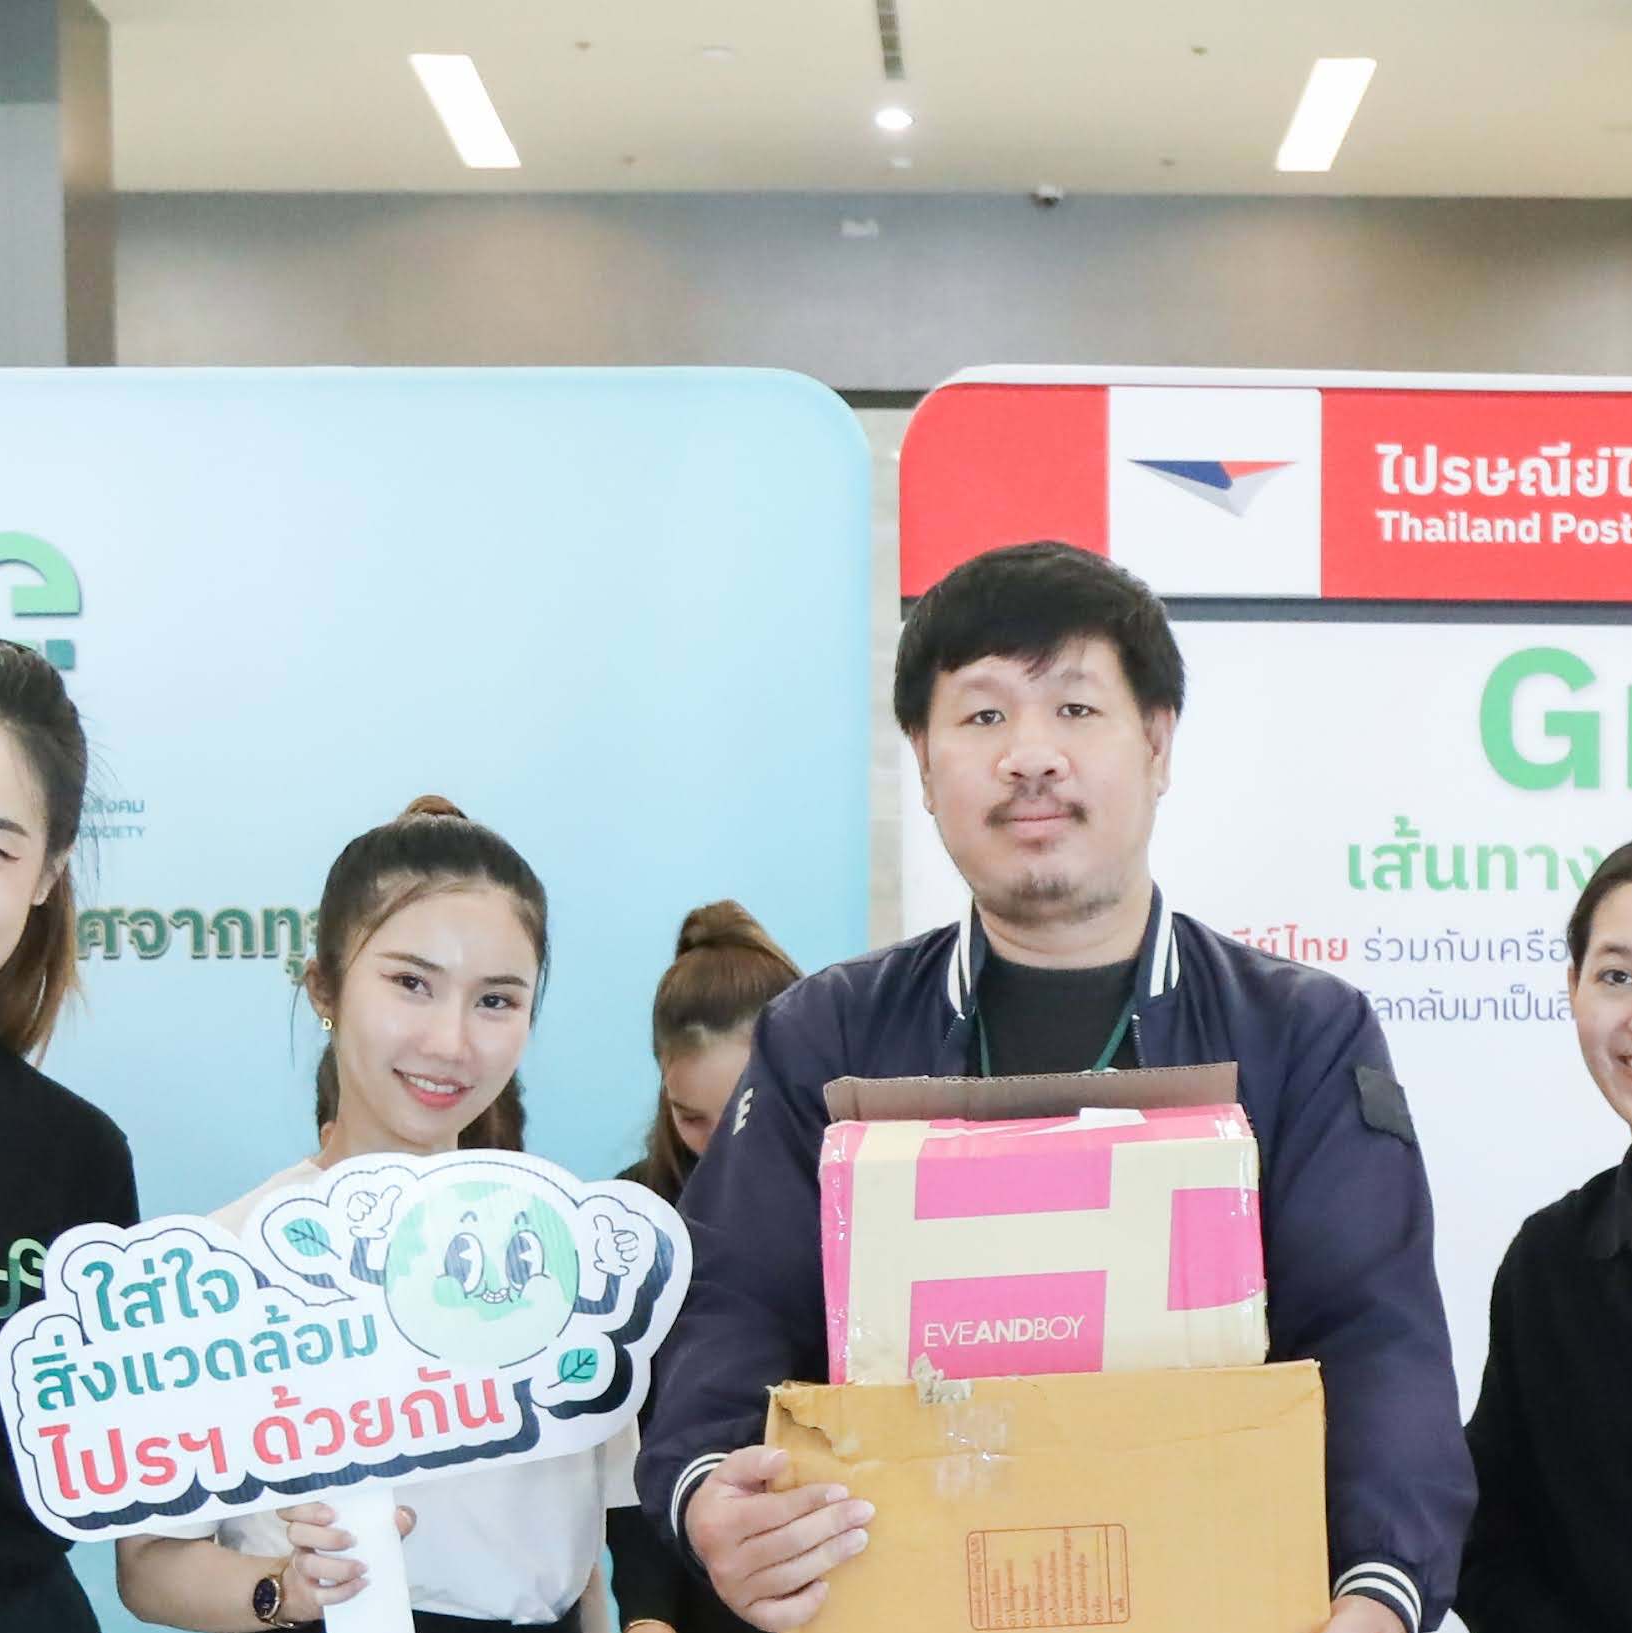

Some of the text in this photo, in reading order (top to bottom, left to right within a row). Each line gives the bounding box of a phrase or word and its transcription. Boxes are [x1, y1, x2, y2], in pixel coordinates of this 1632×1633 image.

[1375, 509, 1541, 543] Thailand
[81, 1247, 241, 1332] ใส่ใจ
[923, 1314, 1086, 1348] EVEANDBOY
[31, 1304, 380, 1411] สิ่งแวดล้อม
[38, 1366, 506, 1500] ไปรฯ ด้วยกัน
